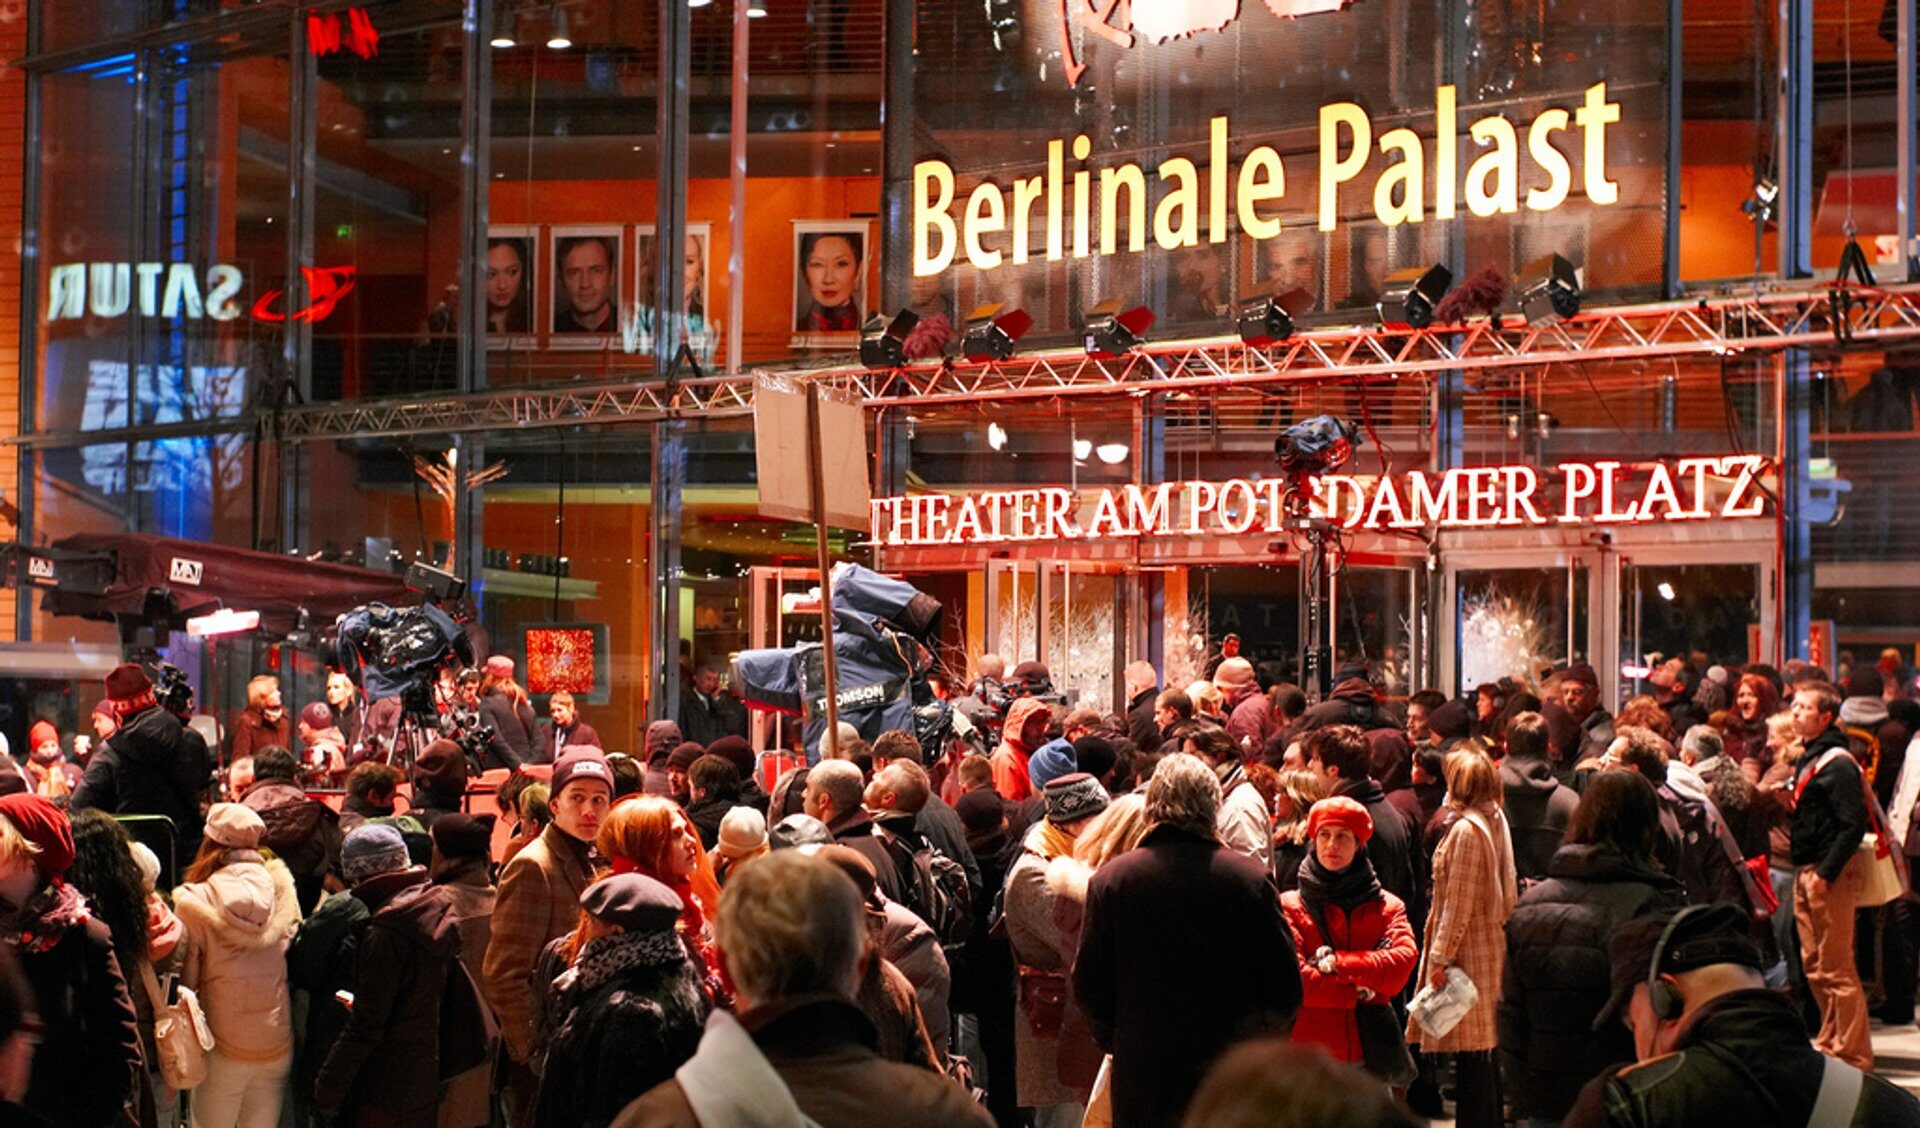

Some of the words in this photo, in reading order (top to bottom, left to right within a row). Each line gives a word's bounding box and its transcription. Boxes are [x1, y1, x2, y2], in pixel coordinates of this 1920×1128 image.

[913, 116, 1285, 277] Berlinale
[1319, 82, 1621, 232] Palast
[869, 488, 1083, 545] THEATER
[1088, 481, 1176, 538] AM
[1558, 456, 1764, 522] PLATZ
